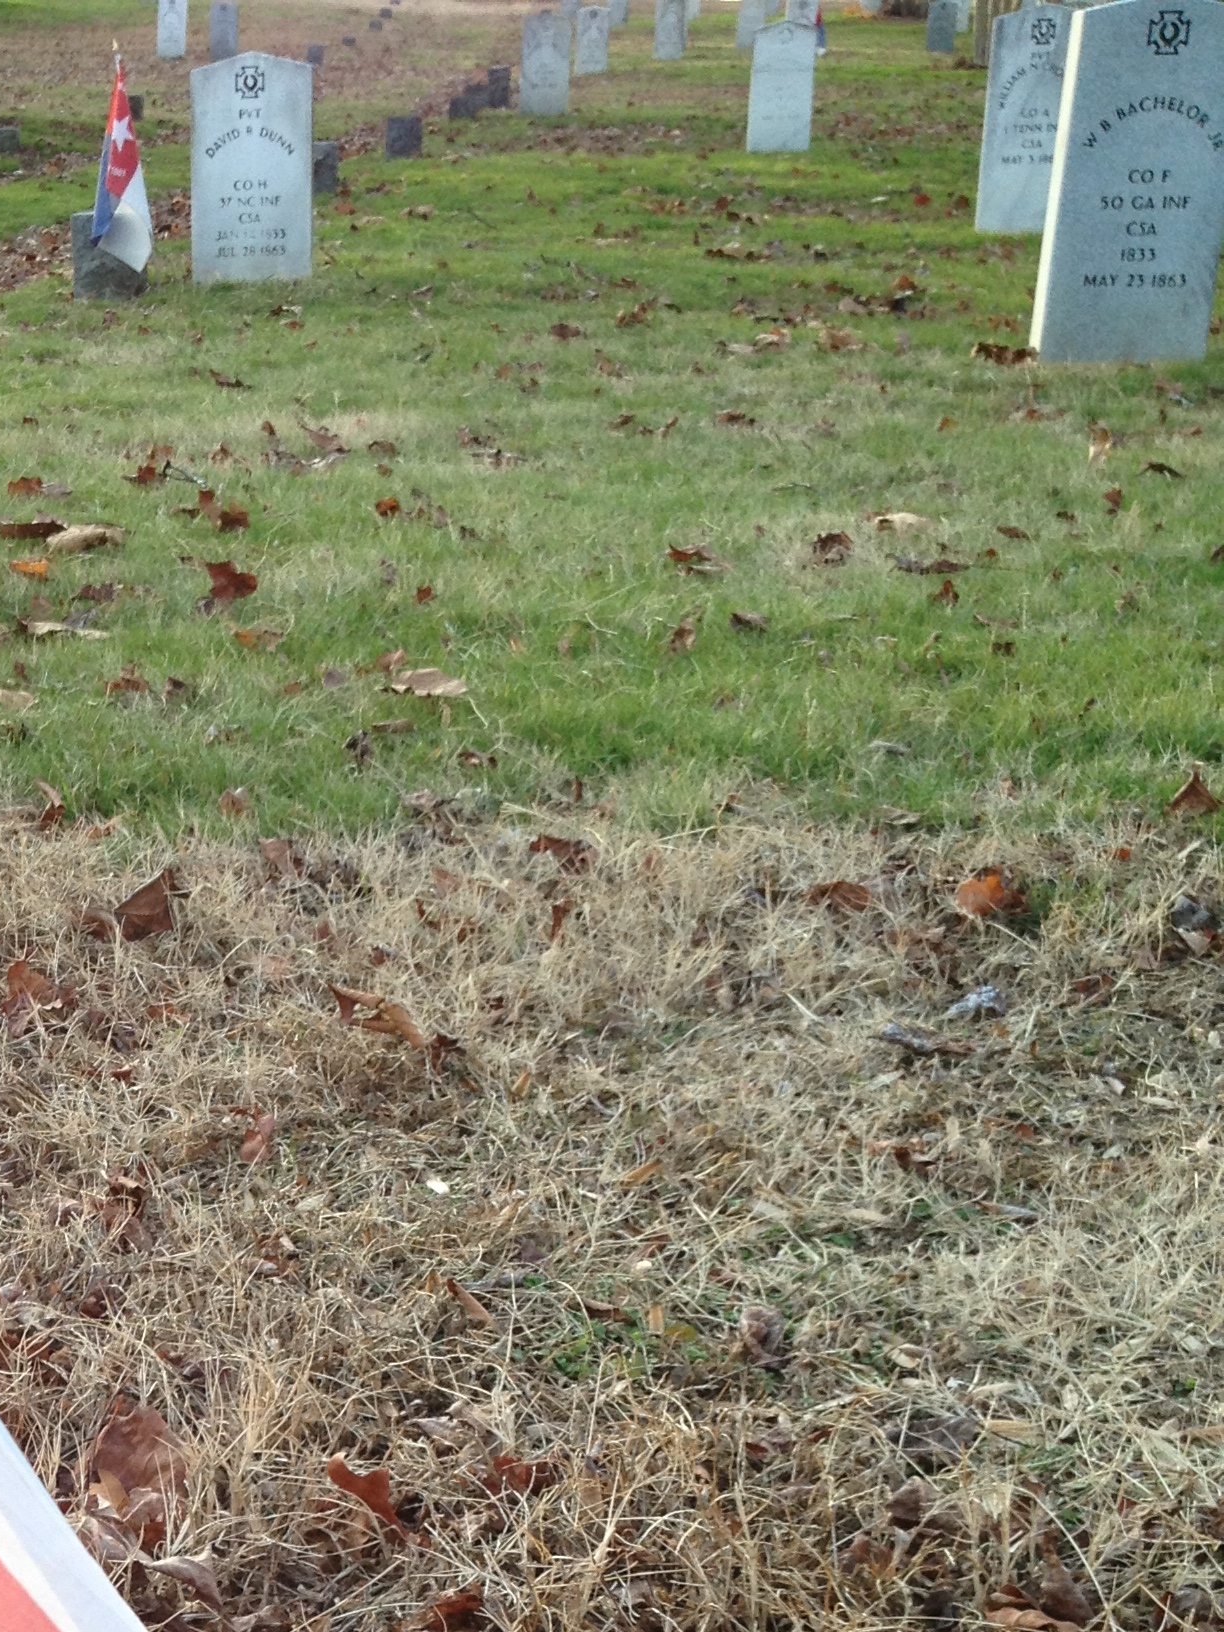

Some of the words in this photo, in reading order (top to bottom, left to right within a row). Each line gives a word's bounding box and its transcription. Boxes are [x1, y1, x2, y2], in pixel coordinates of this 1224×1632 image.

[999, 67, 1027, 109] WILLIAM
[239, 108, 262, 119] PVT
[1013, 124, 1042, 133] TENN
[1046, 124, 1057, 133] IN
[1082, 131, 1098, 148] W
[1099, 119, 1112, 133] B
[1115, 96, 1211, 129] BACHELOR
[1207, 131, 1224, 152] JR
[205, 128, 240, 159] DAVID
[259, 127, 295, 156] DUNN
[1021, 139, 1042, 149] CSA
[1001, 155, 1022, 164] MAY
[1039, 154, 1054, 164] 186
[1128, 168, 1155, 184] CO
[1162, 168, 1172, 184] F
[233, 179, 253, 191] CO
[258, 179, 267, 190] H
[220, 197, 232, 208] 37
[237, 196, 255, 207] NC
[260, 195, 281, 207] INF
[1100, 196, 1124, 210] 50
[1131, 196, 1155, 210] GA
[1163, 196, 1191, 210] INF
[238, 213, 261, 224] CSA
[1126, 222, 1158, 237] CSA
[216, 246, 237, 258] JUL
[1121, 248, 1156, 262] 1833
[1083, 274, 1119, 288] MAY
[1127, 274, 1144, 288] 23
[1151, 273, 1187, 289] 1863
